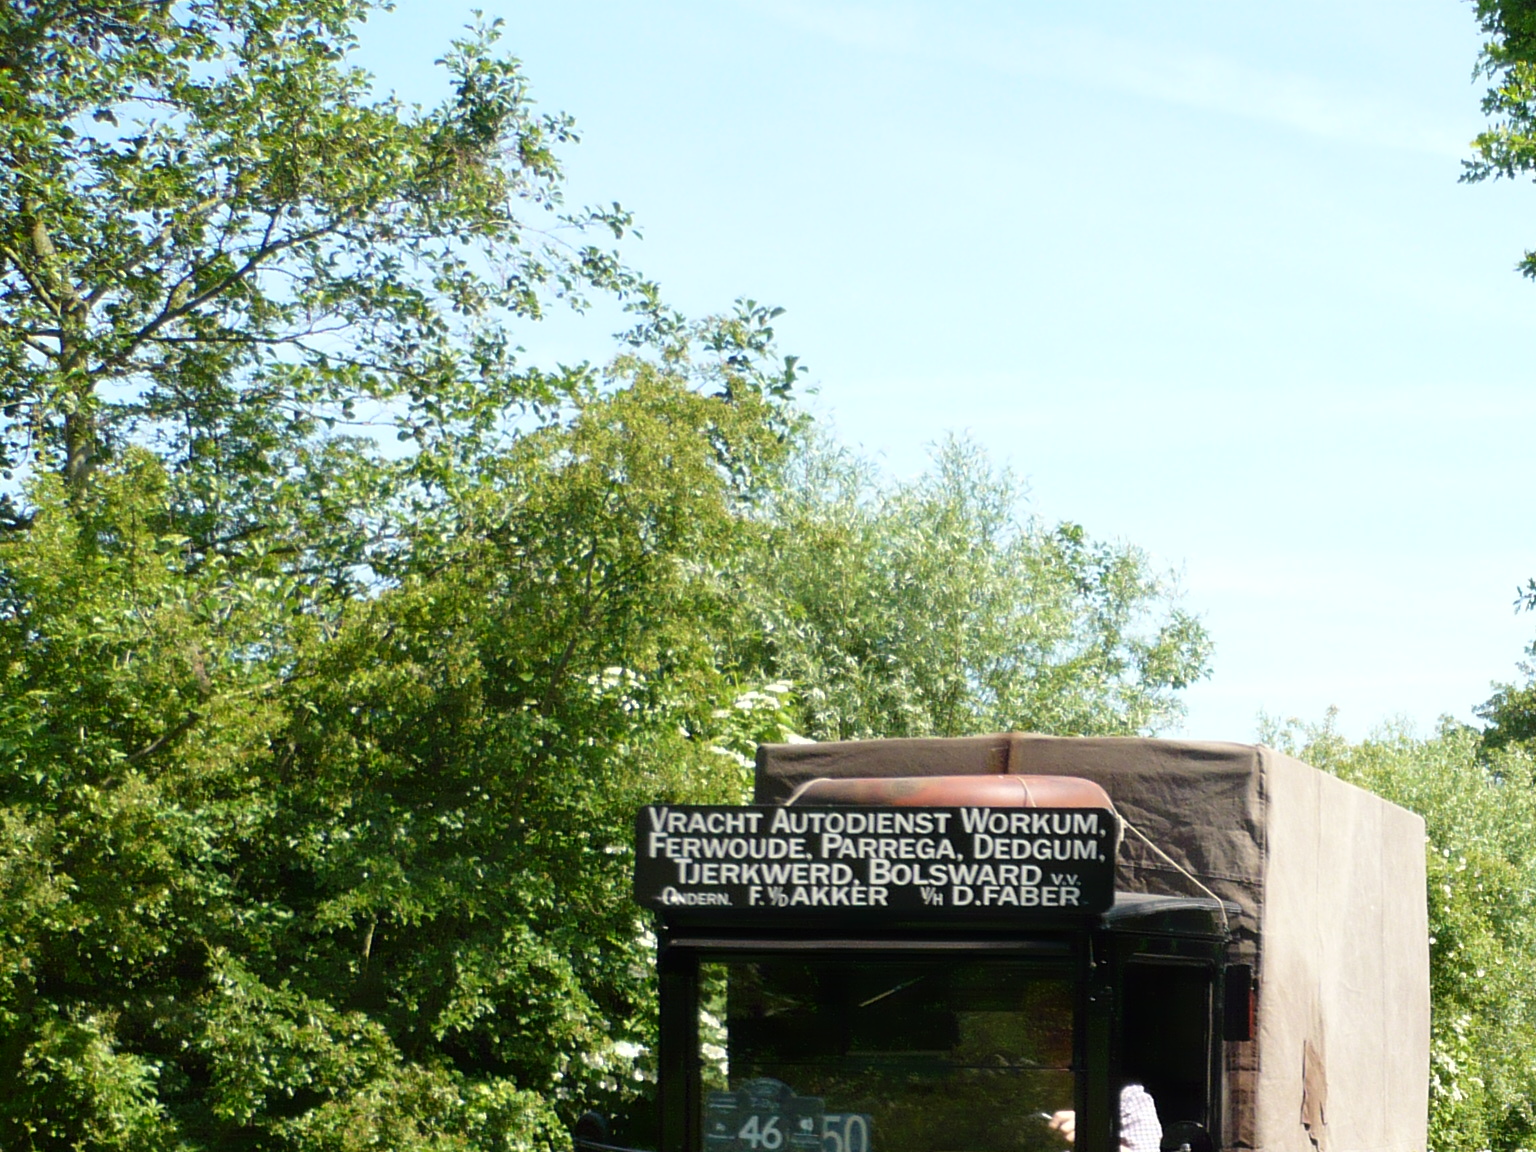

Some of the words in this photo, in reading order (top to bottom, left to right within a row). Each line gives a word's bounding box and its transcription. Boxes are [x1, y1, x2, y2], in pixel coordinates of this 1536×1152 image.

[649, 806, 764, 834] VRACHT
[770, 808, 952, 835] AUTODIENST
[960, 808, 1107, 837] WORKUM,
[649, 832, 813, 861] FERWOUDE,
[821, 833, 963, 862] PARREGA,
[973, 833, 1106, 863] DEDGUM,
[868, 858, 1043, 886] BOLSWARD
[738, 1115, 783, 1150] 46
